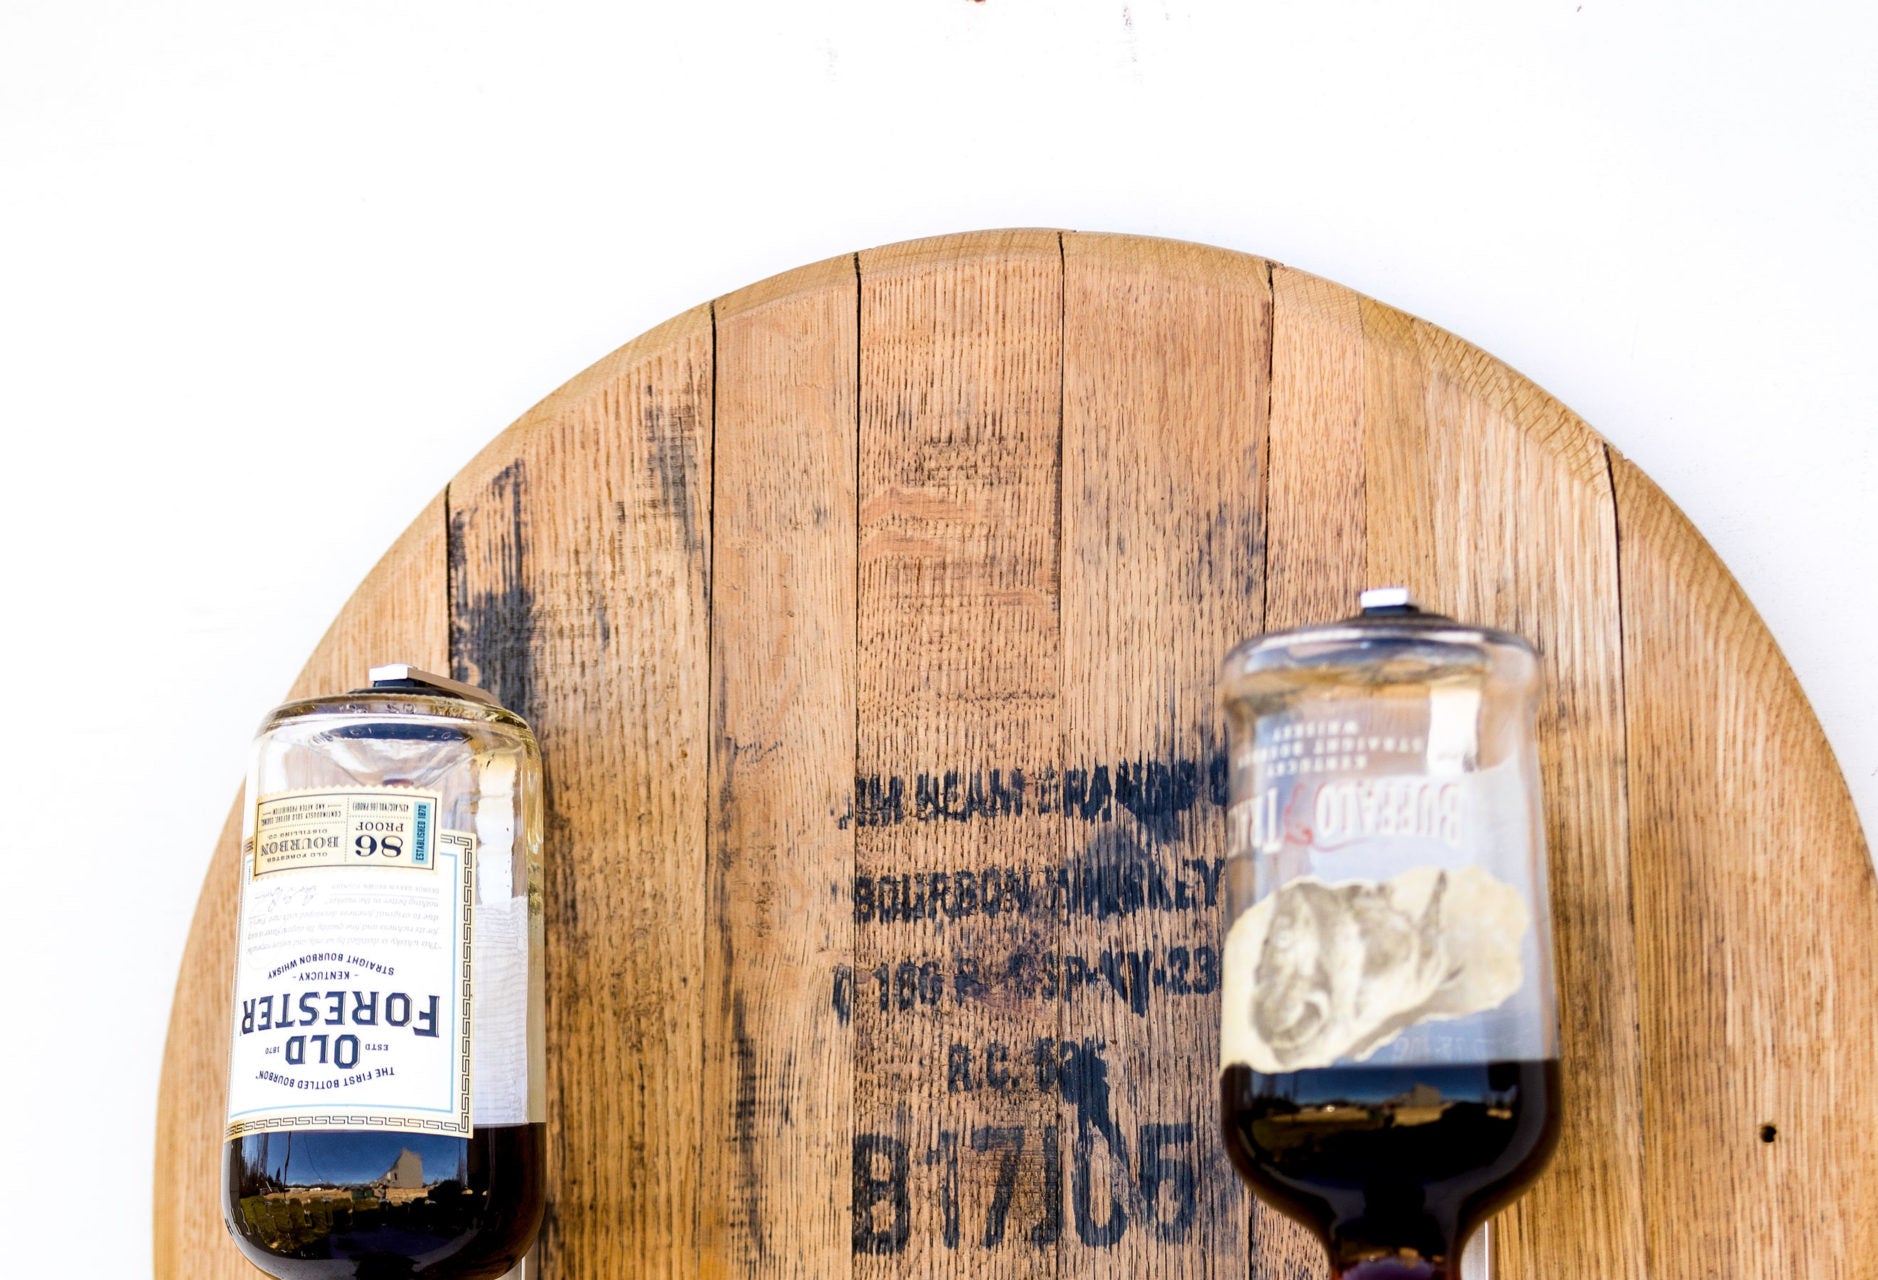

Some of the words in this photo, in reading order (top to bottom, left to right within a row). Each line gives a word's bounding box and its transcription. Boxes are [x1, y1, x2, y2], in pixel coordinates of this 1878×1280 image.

[356, 822, 404, 832] PROOF
[261, 836, 339, 856] BOURBON
[355, 835, 403, 858] 86
[416, 821, 426, 861] ESTABLISHED
[299, 952, 343, 964] BOURBON
[346, 954, 394, 976] STRAIGHT
[267, 959, 297, 979] WHISKY
[298, 971, 350, 981] KENTUCKY
[240, 990, 440, 1038] FORESTER
[285, 1034, 361, 1069] OLD
[365, 1043, 389, 1051] ESTD
[257, 1070, 295, 1087] BOURBON
[343, 1070, 372, 1087] FIRST
[375, 1066, 395, 1078] THE
[297, 1079, 339, 1090] BOTTLED
